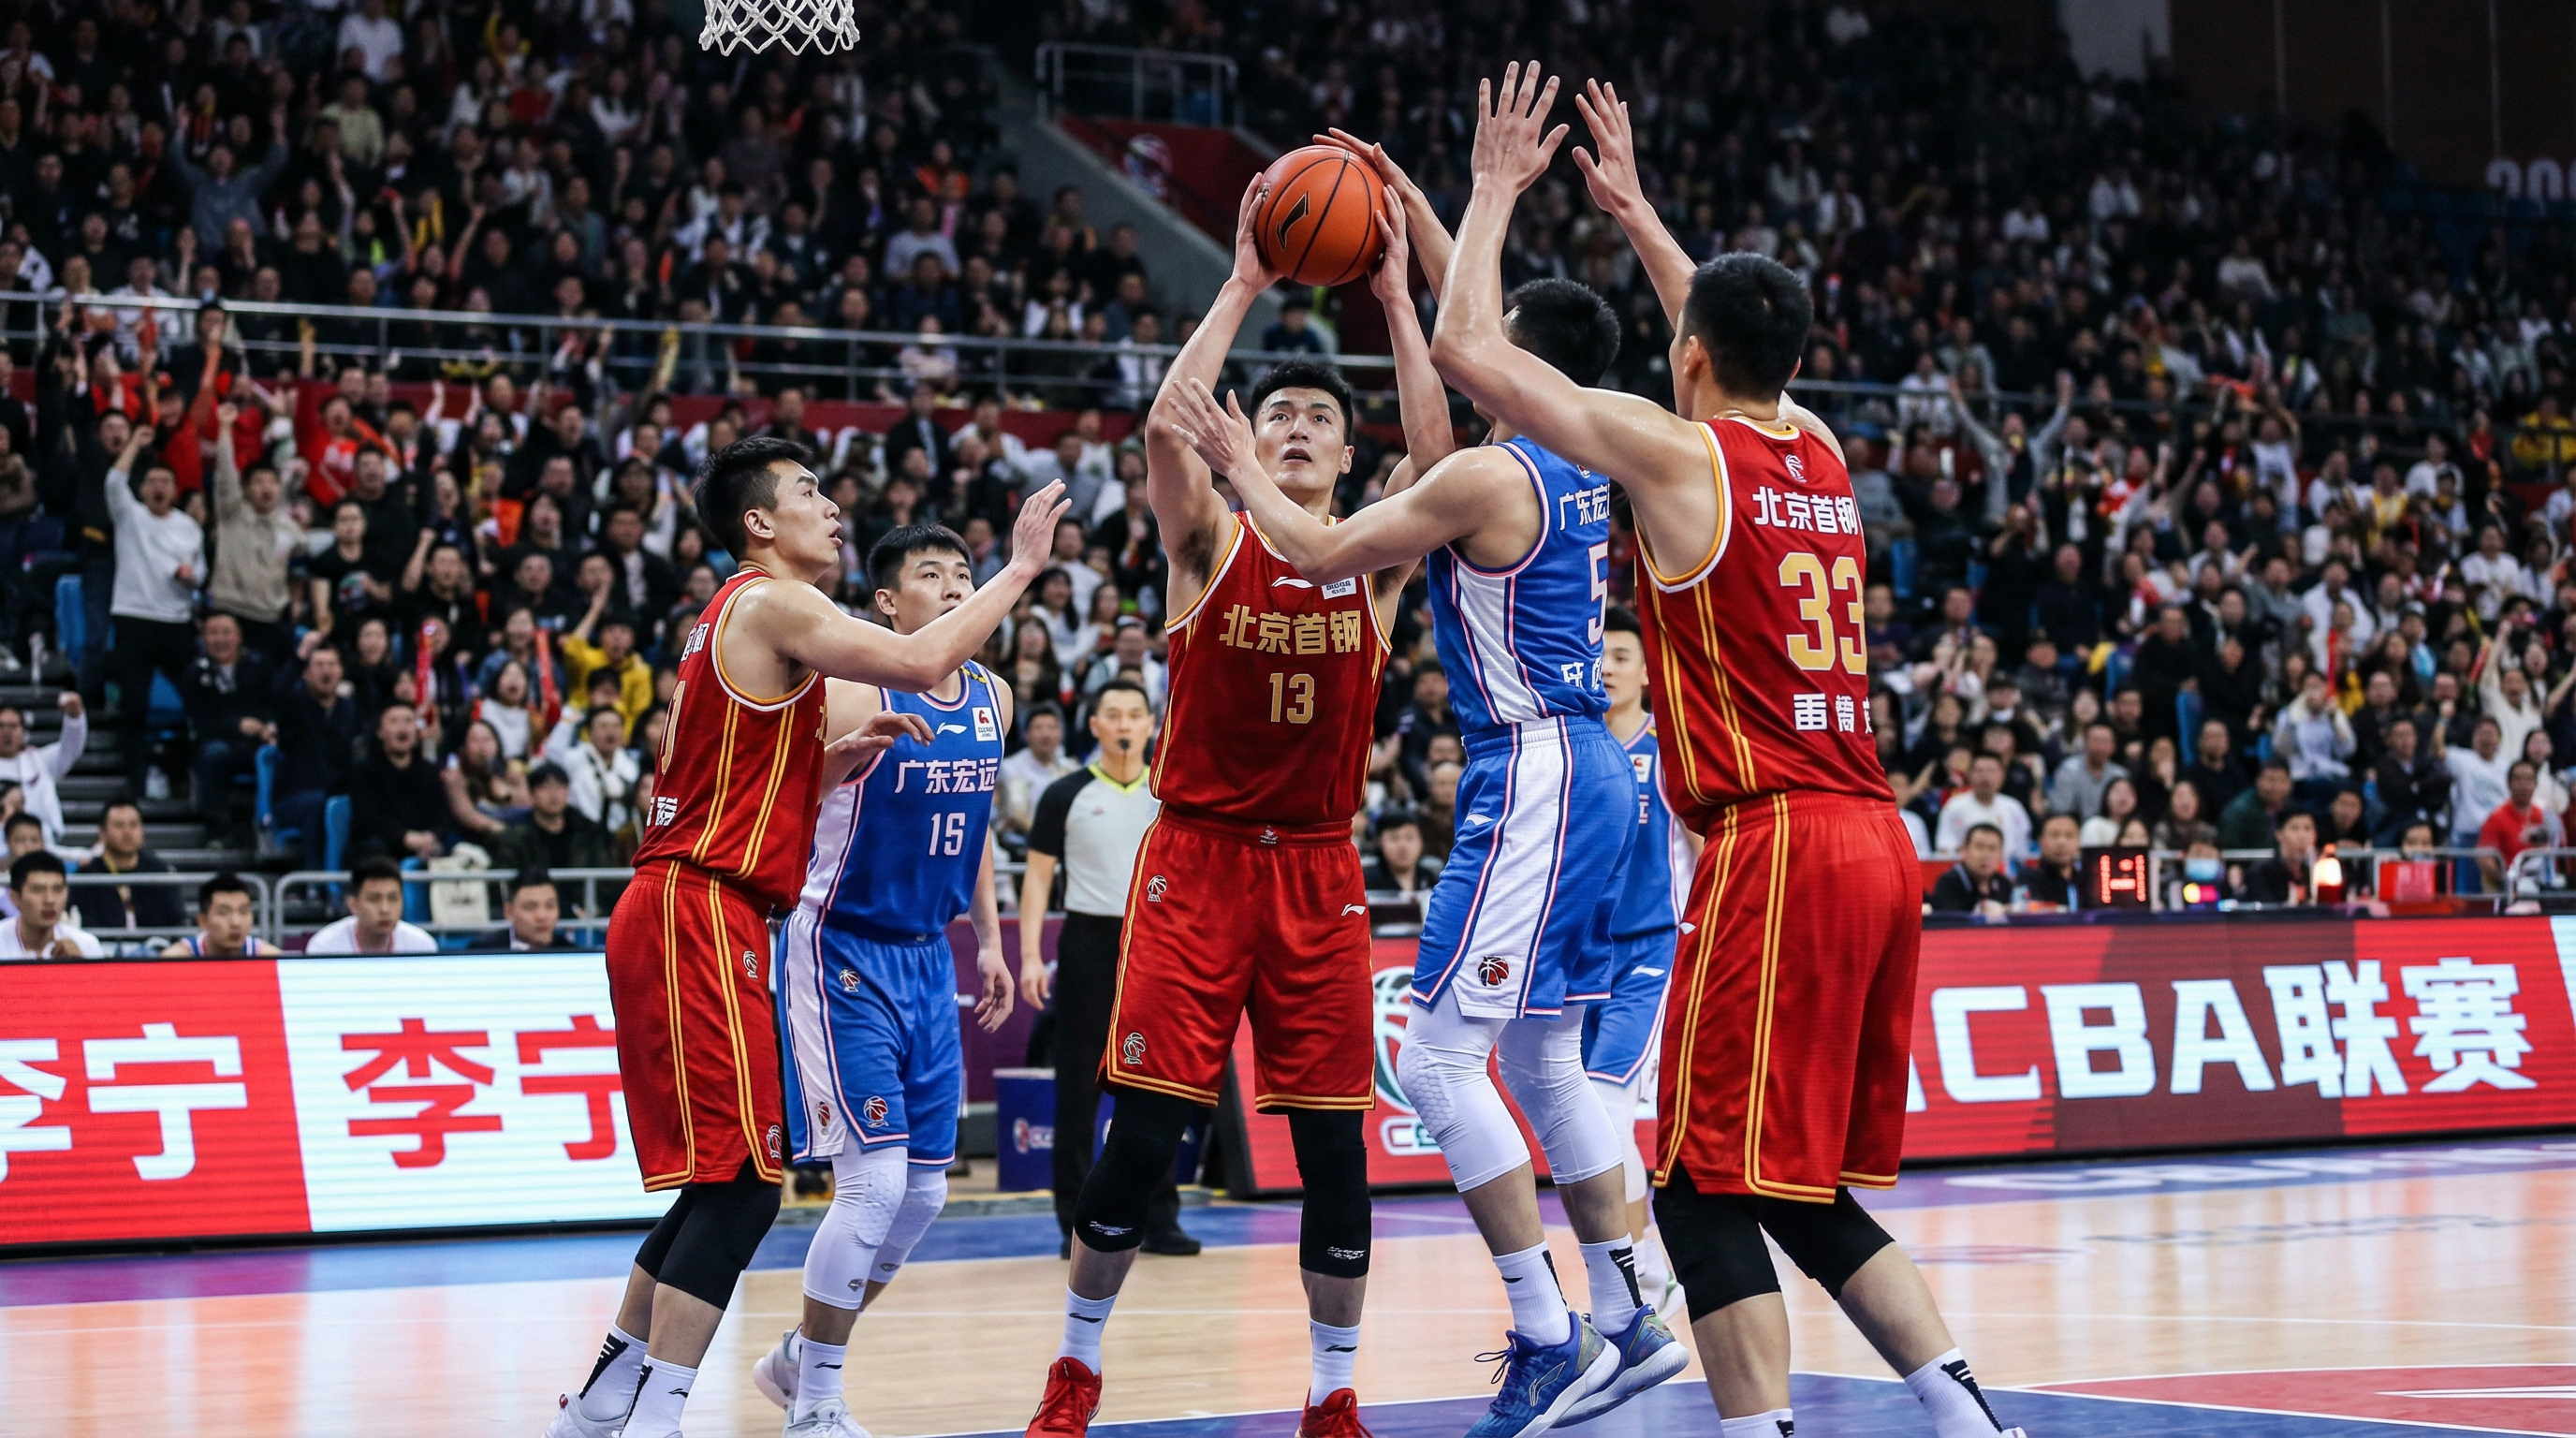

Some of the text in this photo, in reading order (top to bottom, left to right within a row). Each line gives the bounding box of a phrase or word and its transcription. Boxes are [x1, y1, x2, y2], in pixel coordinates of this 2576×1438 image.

[1559, 483, 1610, 531] 广东宏
[1752, 486, 1858, 535] 北京首钢
[1220, 604, 1361, 654] 北京首钢
[1778, 552, 1867, 675] 33
[1269, 673, 1314, 724] 13
[895, 758, 998, 794] 广东宏远
[929, 813, 966, 856] 15
[1906, 958, 2539, 1112] CBA联赛
[341, 1016, 624, 1169] 李宁
